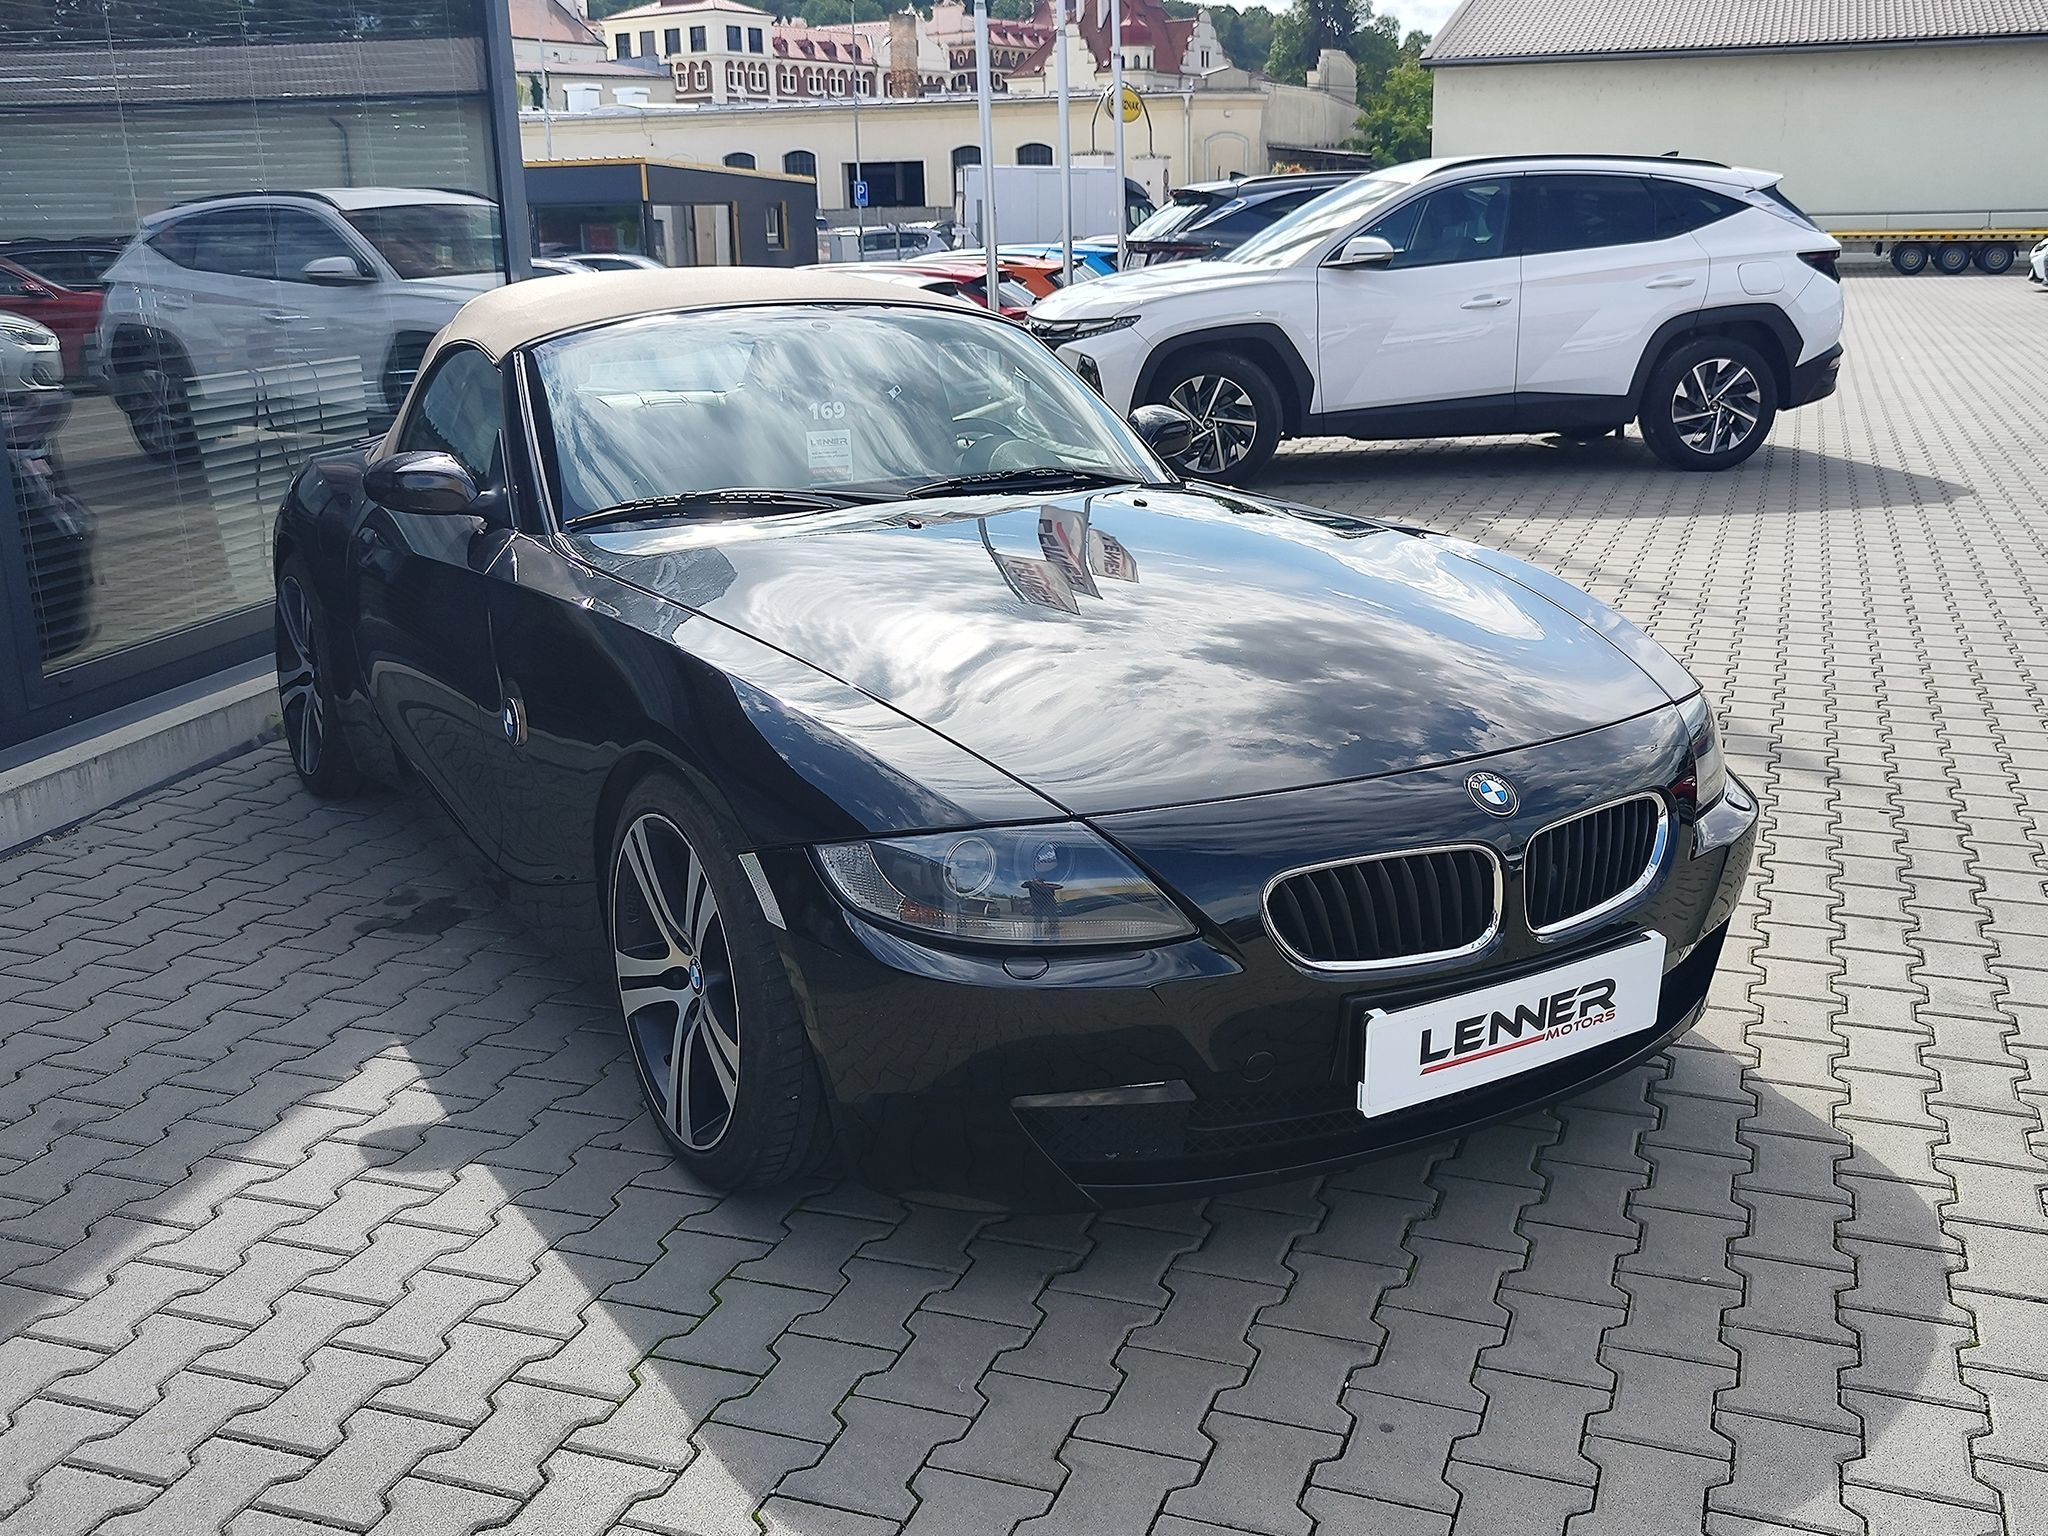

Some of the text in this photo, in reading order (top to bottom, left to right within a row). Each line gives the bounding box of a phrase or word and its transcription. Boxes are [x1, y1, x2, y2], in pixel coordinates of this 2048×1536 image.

[857, 184, 865, 200] P
[808, 401, 846, 420] 169
[1471, 774, 1503, 790] BMW
[1420, 978, 1616, 1065] LENNER
[1545, 1009, 1616, 1041] MOTORS
